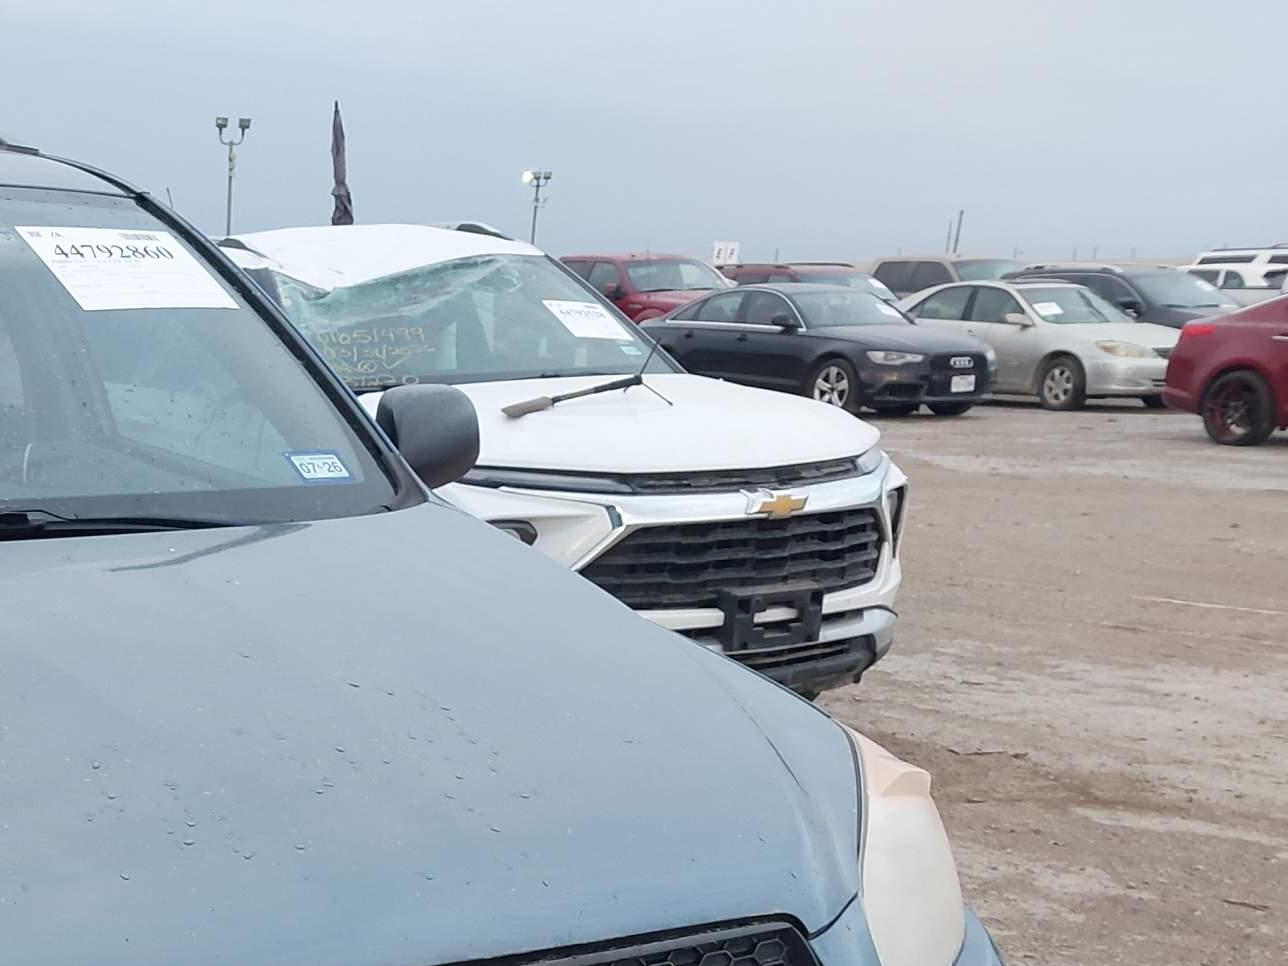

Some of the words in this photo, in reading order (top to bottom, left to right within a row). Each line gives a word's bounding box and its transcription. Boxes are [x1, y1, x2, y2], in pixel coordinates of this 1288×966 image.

[53, 244, 175, 260] 44792860
[298, 462, 318, 474] 07
[323, 461, 344, 473] 26
